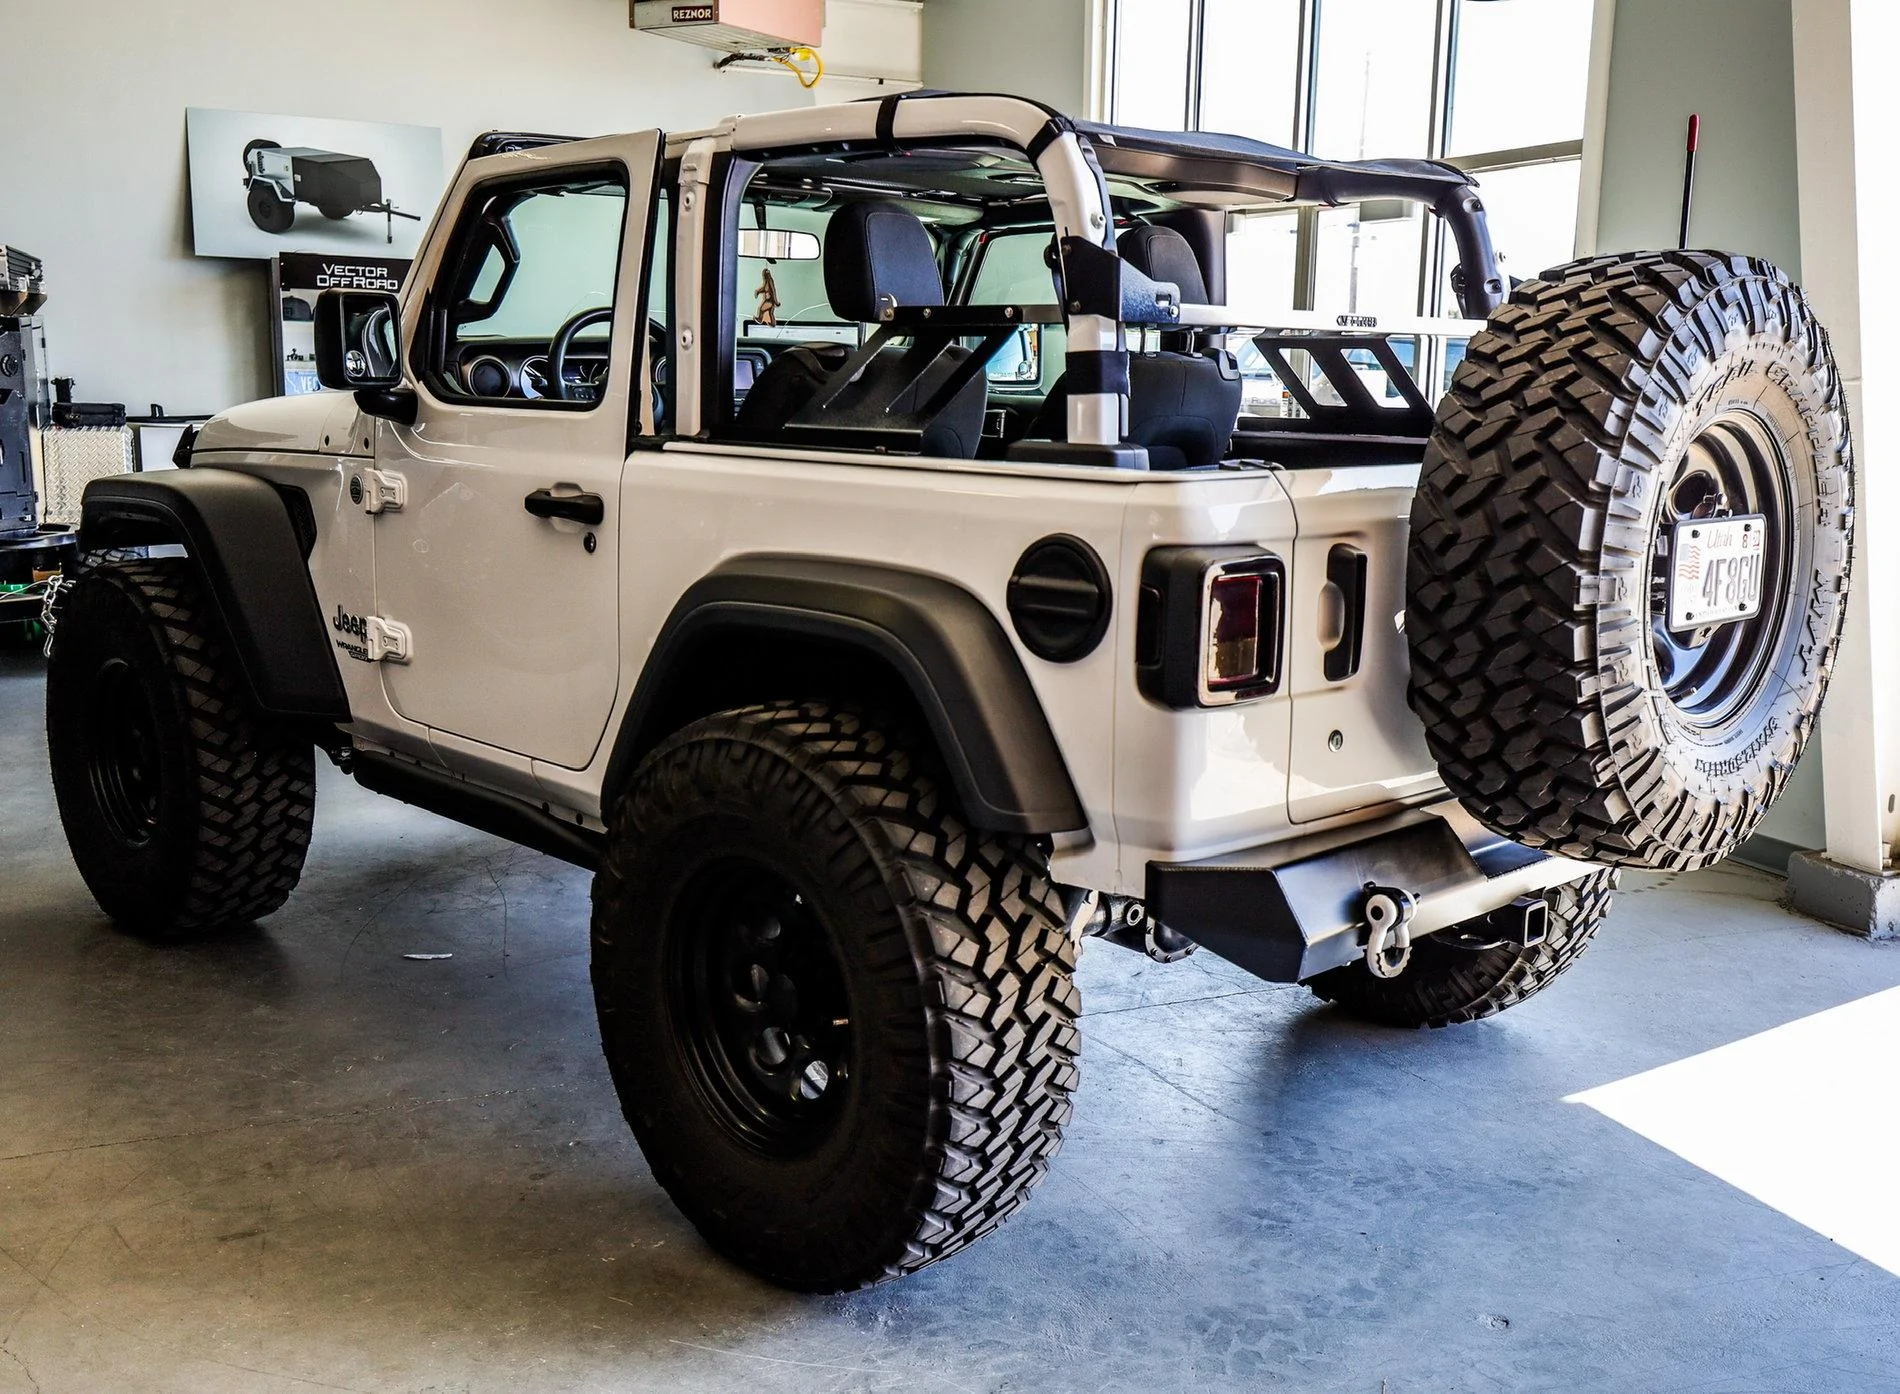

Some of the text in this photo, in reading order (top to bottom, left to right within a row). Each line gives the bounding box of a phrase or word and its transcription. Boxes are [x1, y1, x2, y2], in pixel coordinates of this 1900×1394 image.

[673, 9, 712, 19] REZNOR
[322, 263, 388, 278] VECTOR
[1706, 525, 1733, 550] Utah
[333, 605, 367, 644] Jeep
